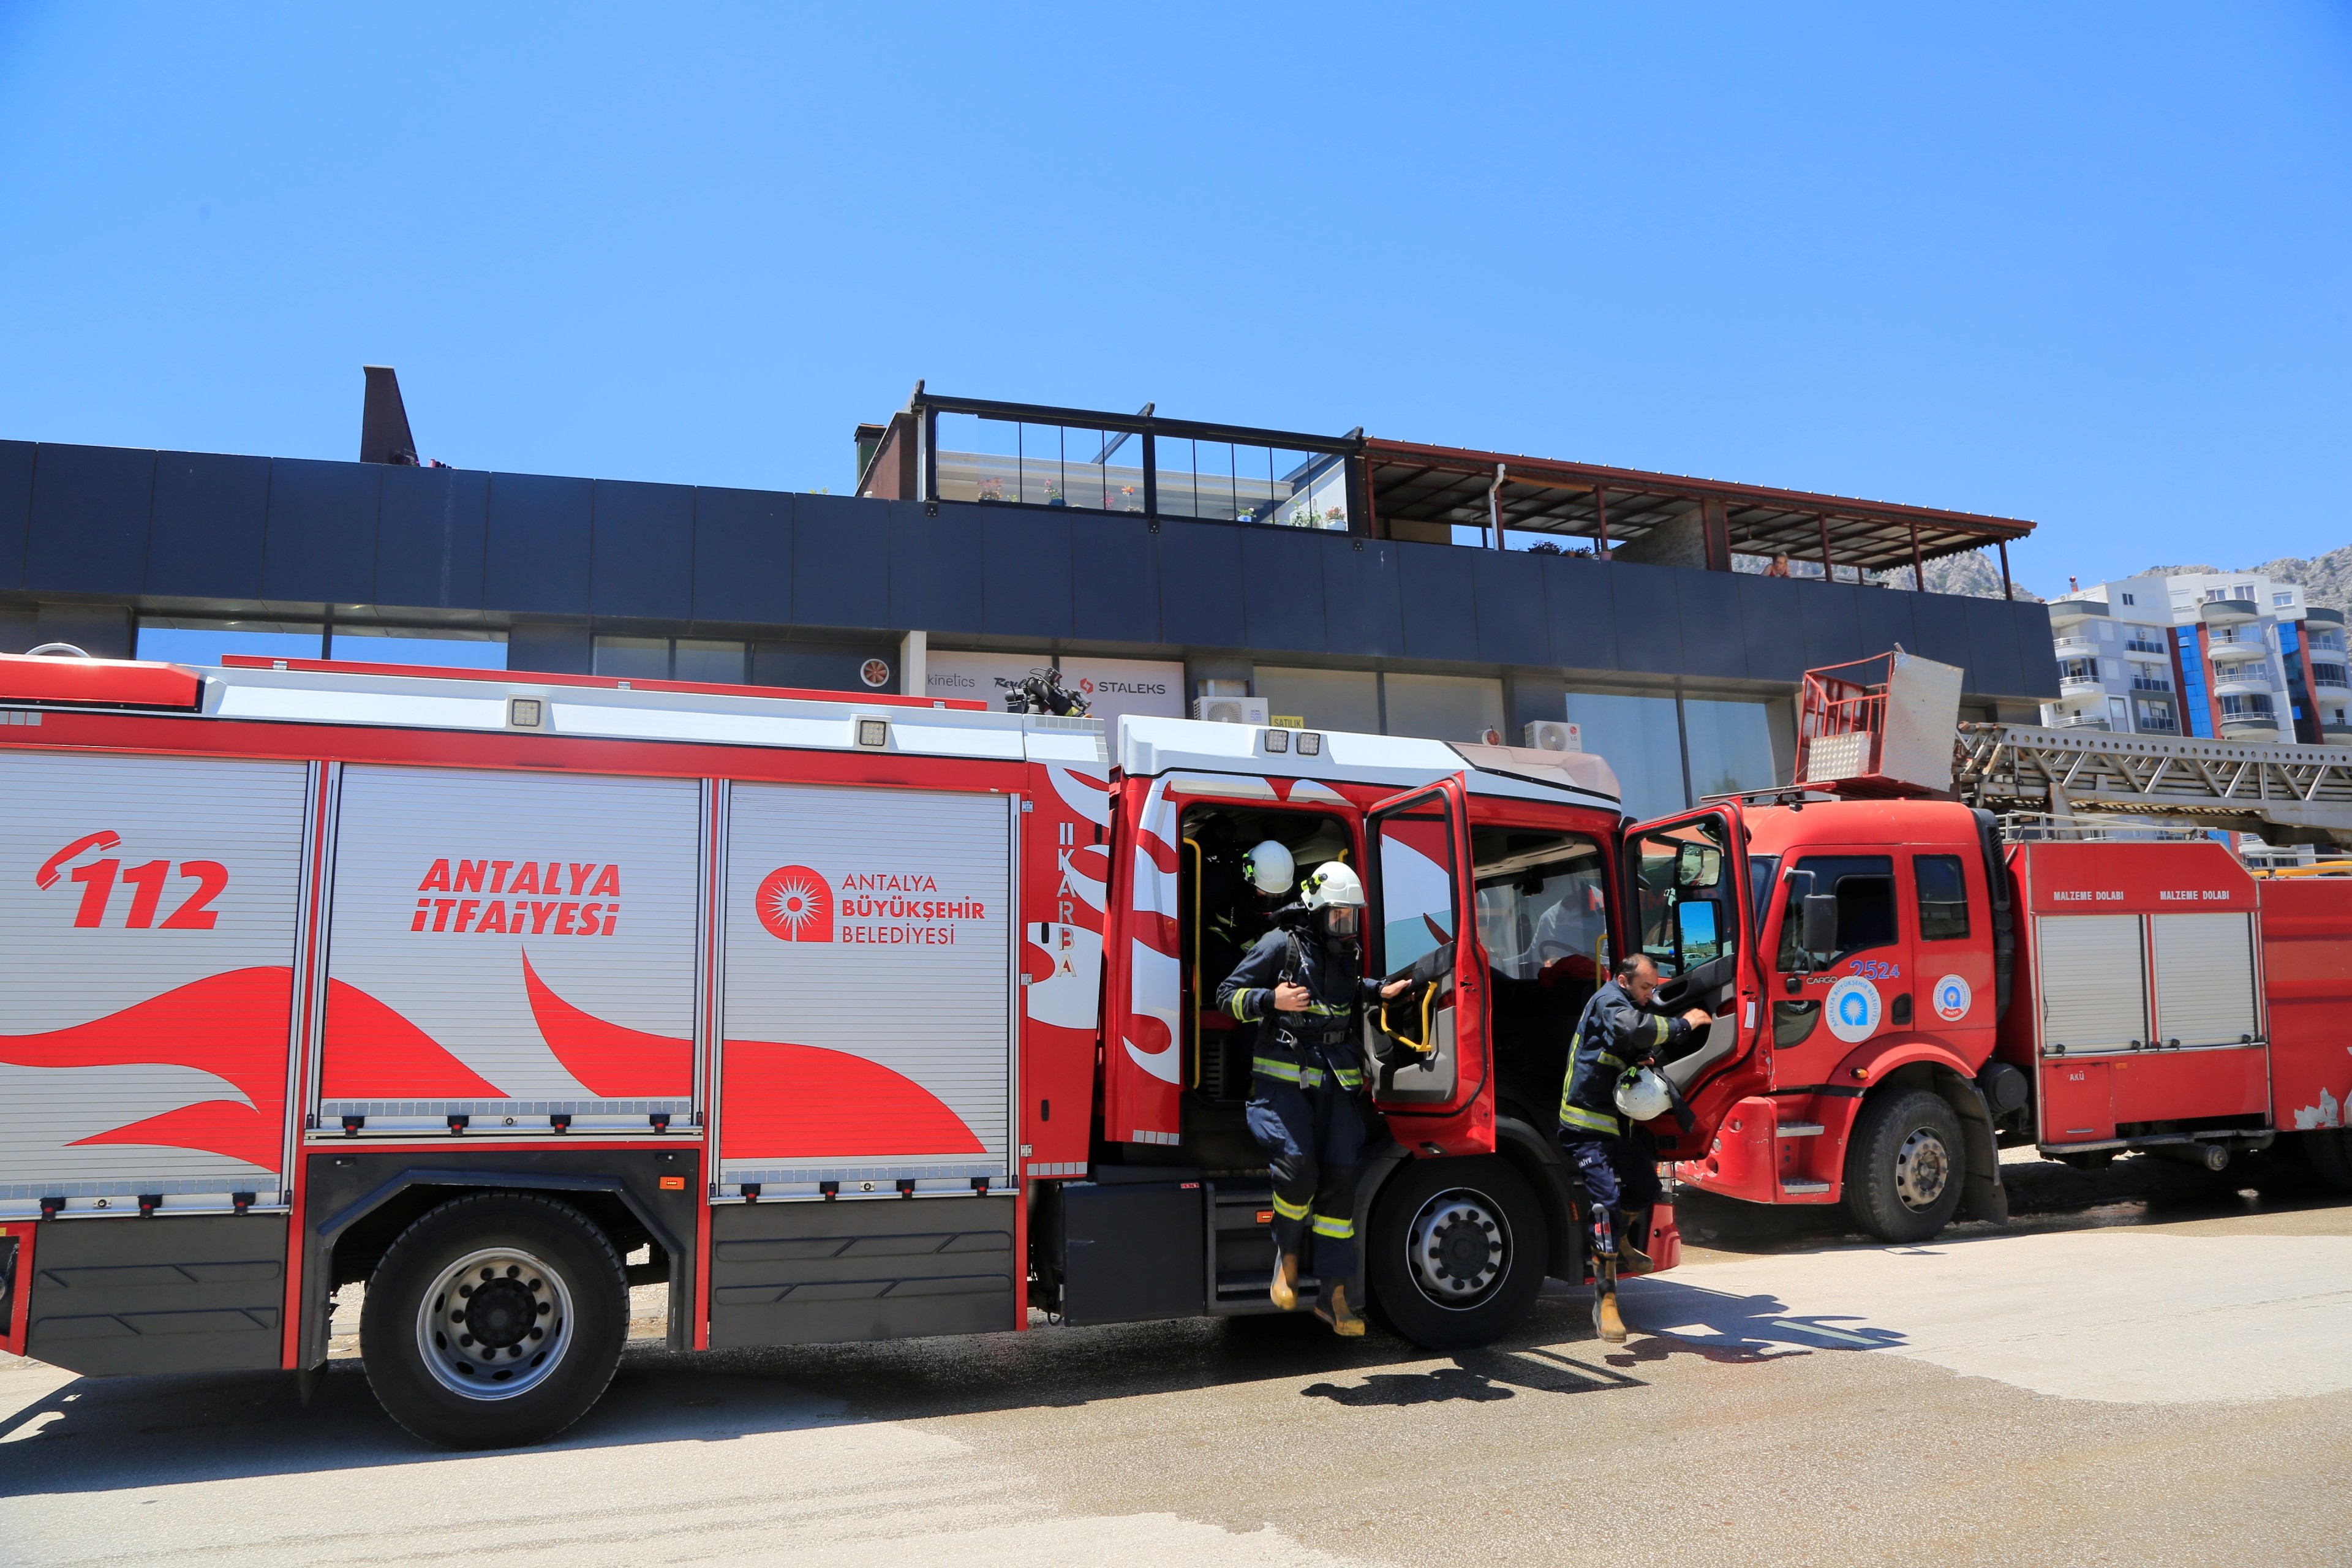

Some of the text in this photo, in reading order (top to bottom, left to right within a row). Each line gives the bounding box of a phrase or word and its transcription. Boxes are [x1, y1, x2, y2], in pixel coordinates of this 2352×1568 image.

[927, 673, 975, 688] kinetics
[1098, 681, 1166, 695] STALEKS
[1274, 718, 1302, 728] SATILIK
[417, 858, 620, 897] ANTALYA
[842, 873, 938, 892] ANTALYA
[70, 859, 228, 929] 112
[2053, 891, 2124, 901] MALZEME DOLABI
[2160, 890, 2230, 900] MALZEME DOLABI
[410, 898, 620, 936] İTFAİYESİ
[842, 894, 986, 922] BÜYÜKŞEHİR
[842, 922, 955, 945] BELEDİYESİ
[1849, 960, 1900, 981] 2524
[1829, 997, 1838, 1027] ANTALYA
[2070, 1071, 2084, 1081] AKÜ
